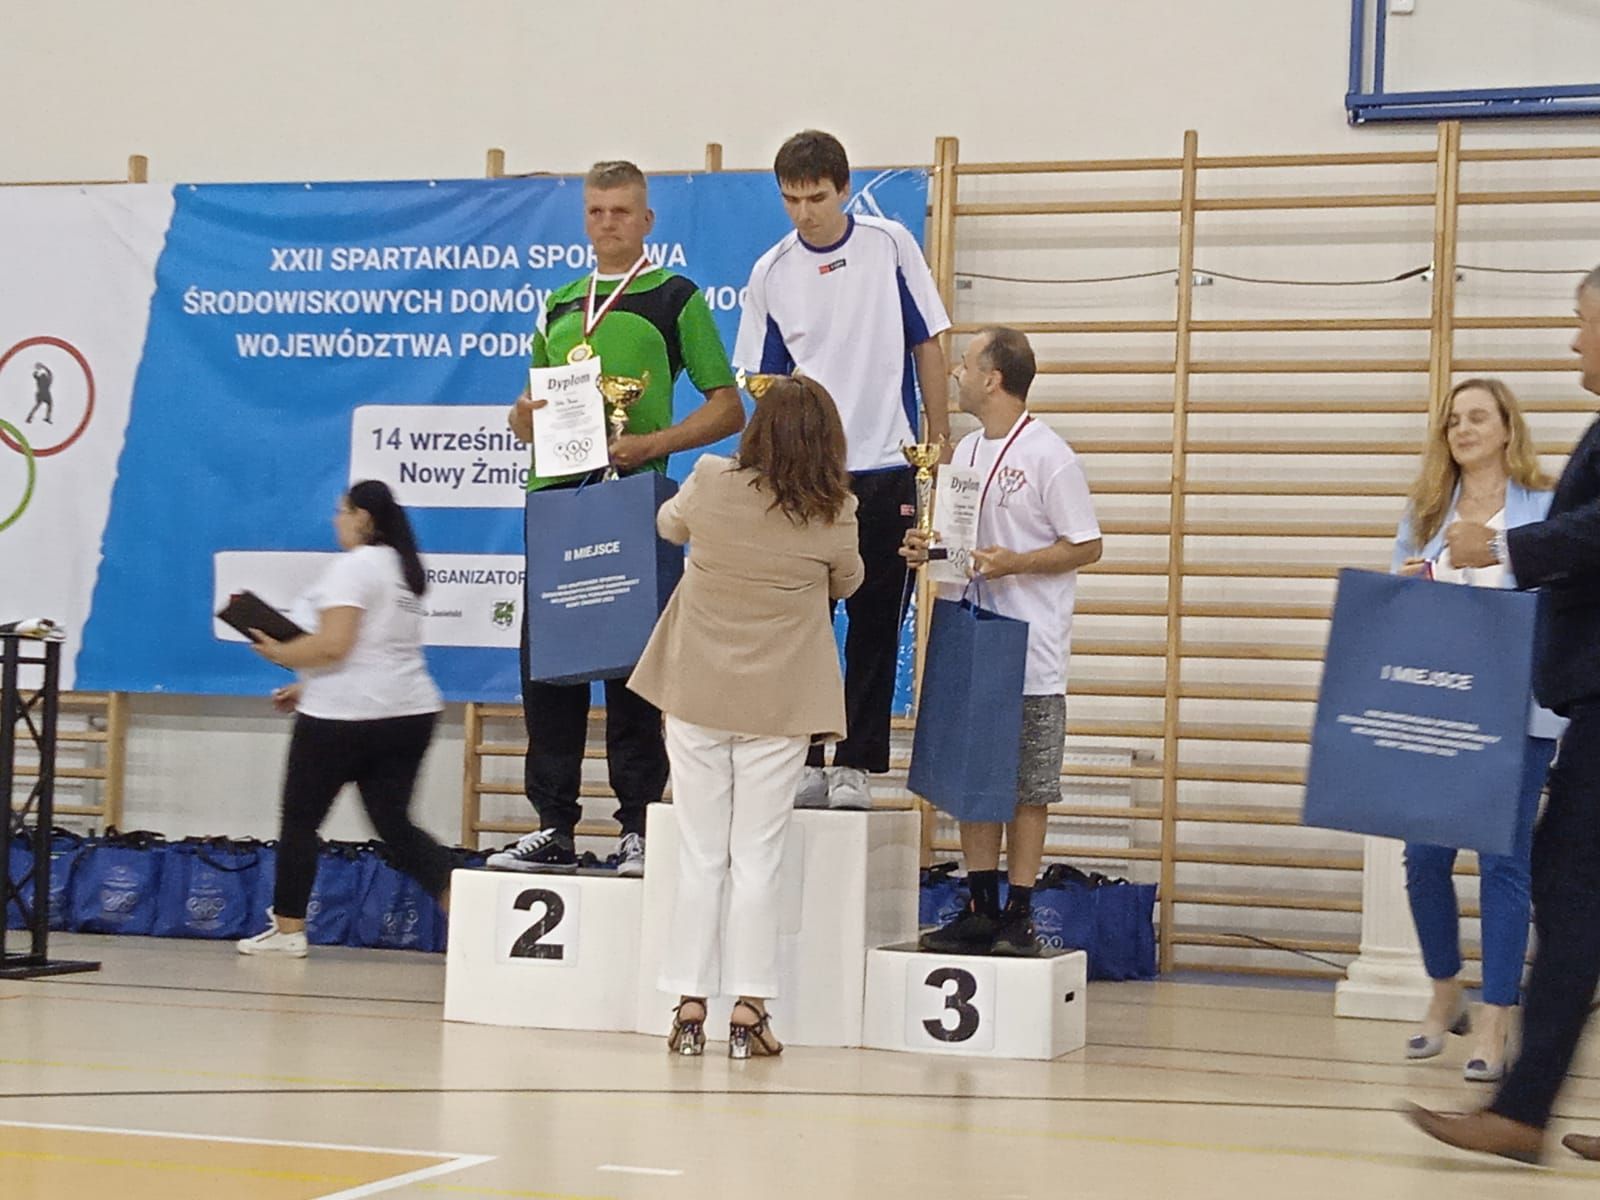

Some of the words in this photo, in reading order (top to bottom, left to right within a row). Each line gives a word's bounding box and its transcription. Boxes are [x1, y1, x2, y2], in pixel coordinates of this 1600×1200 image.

[270, 247, 323, 271] XXII
[330, 245, 520, 271] SPARTAKIADA
[183, 285, 443, 314] ŚRODOWISKOWYCH
[235, 328, 453, 357] WOJEWÓDZTWA
[547, 373, 591, 392] Dyplom
[372, 427, 402, 450] 14
[400, 462, 465, 489] Nowy
[564, 550, 573, 562] II
[573, 541, 621, 560] MIEJSCE
[1390, 666, 1475, 691] MIEJSCE
[509, 888, 565, 960] 2
[922, 967, 980, 1043] 3
